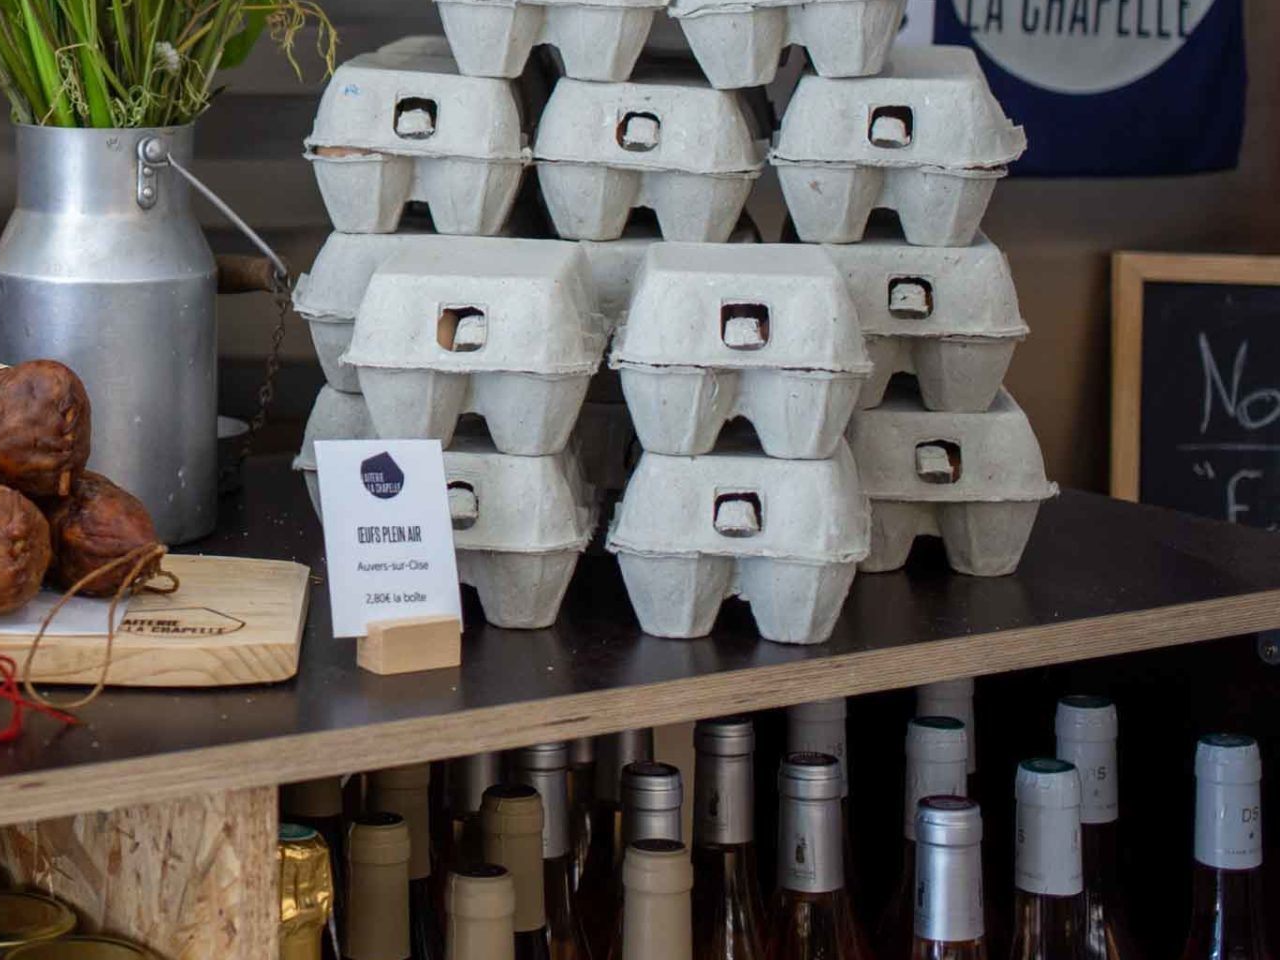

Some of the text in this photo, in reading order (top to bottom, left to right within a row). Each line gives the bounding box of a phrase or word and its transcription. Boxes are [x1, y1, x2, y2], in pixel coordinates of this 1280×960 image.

[357, 526, 422, 544] ŒUFS PLEIN AIR
[357, 559, 429, 572] Auvers-sur-Oise
[365, 591, 427, 605] 2,80€ la boîte
[151, 626, 227, 635] CHAPELLE
